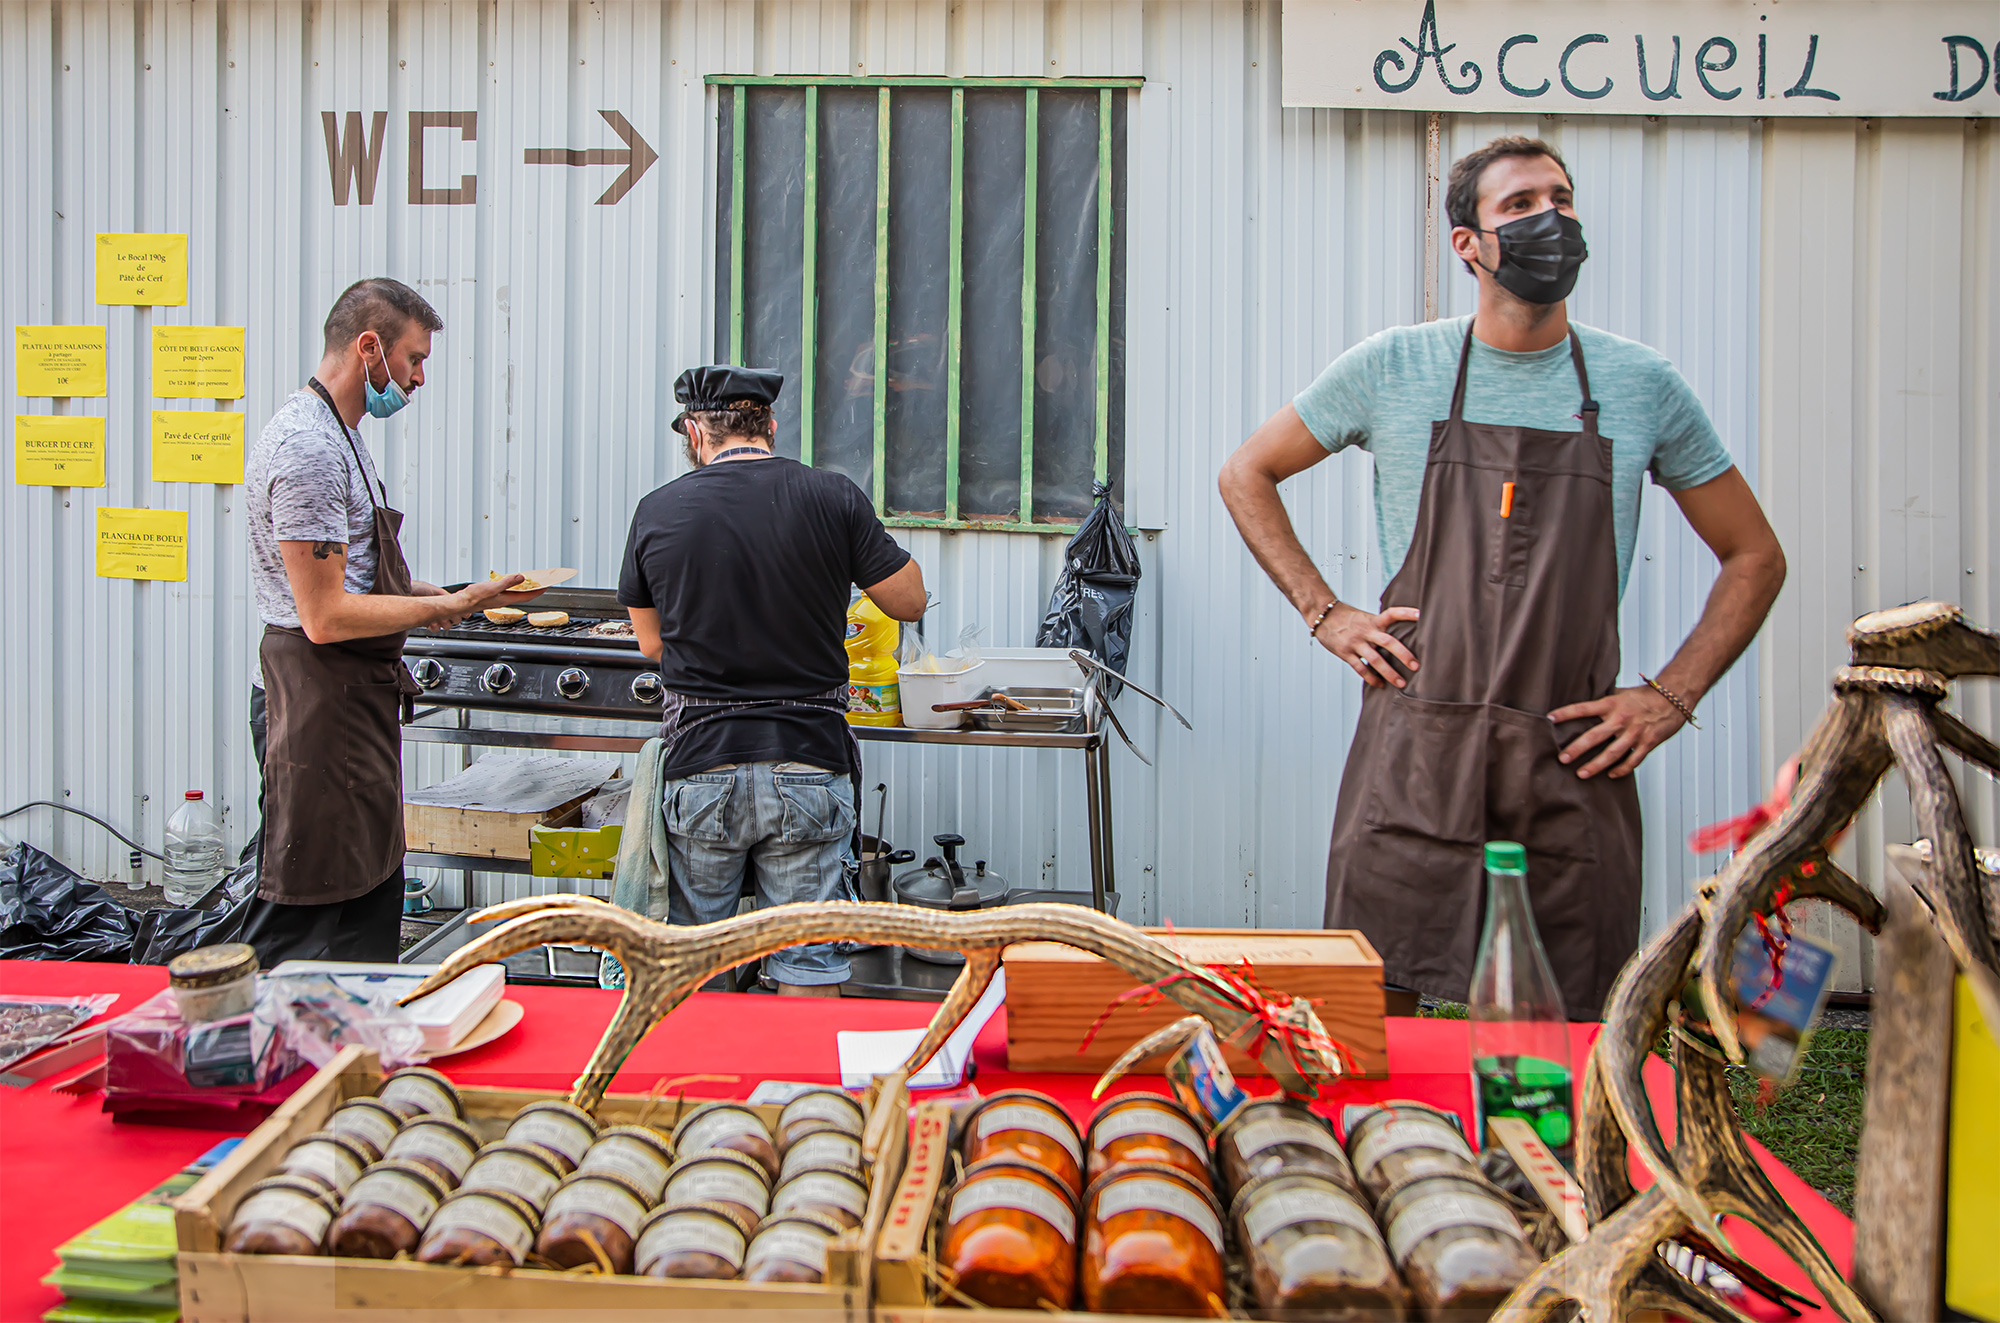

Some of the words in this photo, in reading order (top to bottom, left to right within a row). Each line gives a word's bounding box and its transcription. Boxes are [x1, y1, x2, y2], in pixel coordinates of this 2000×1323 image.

[1932, 35, 2000, 102] D
[321, 111, 477, 206] WC
[117, 253, 126, 261] Le
[128, 253, 147, 261] Bocal
[149, 253, 166, 263] 190g
[136, 274, 146, 282] de
[147, 274, 163, 282] Cerf
[182, 432, 192, 440] de
[193, 432, 210, 440] Cerf
[211, 433, 231, 442] grillé
[25, 440, 58, 448] BURGER
[101, 532, 141, 541] PLANCHA
[156, 535, 184, 543] BOEUF
